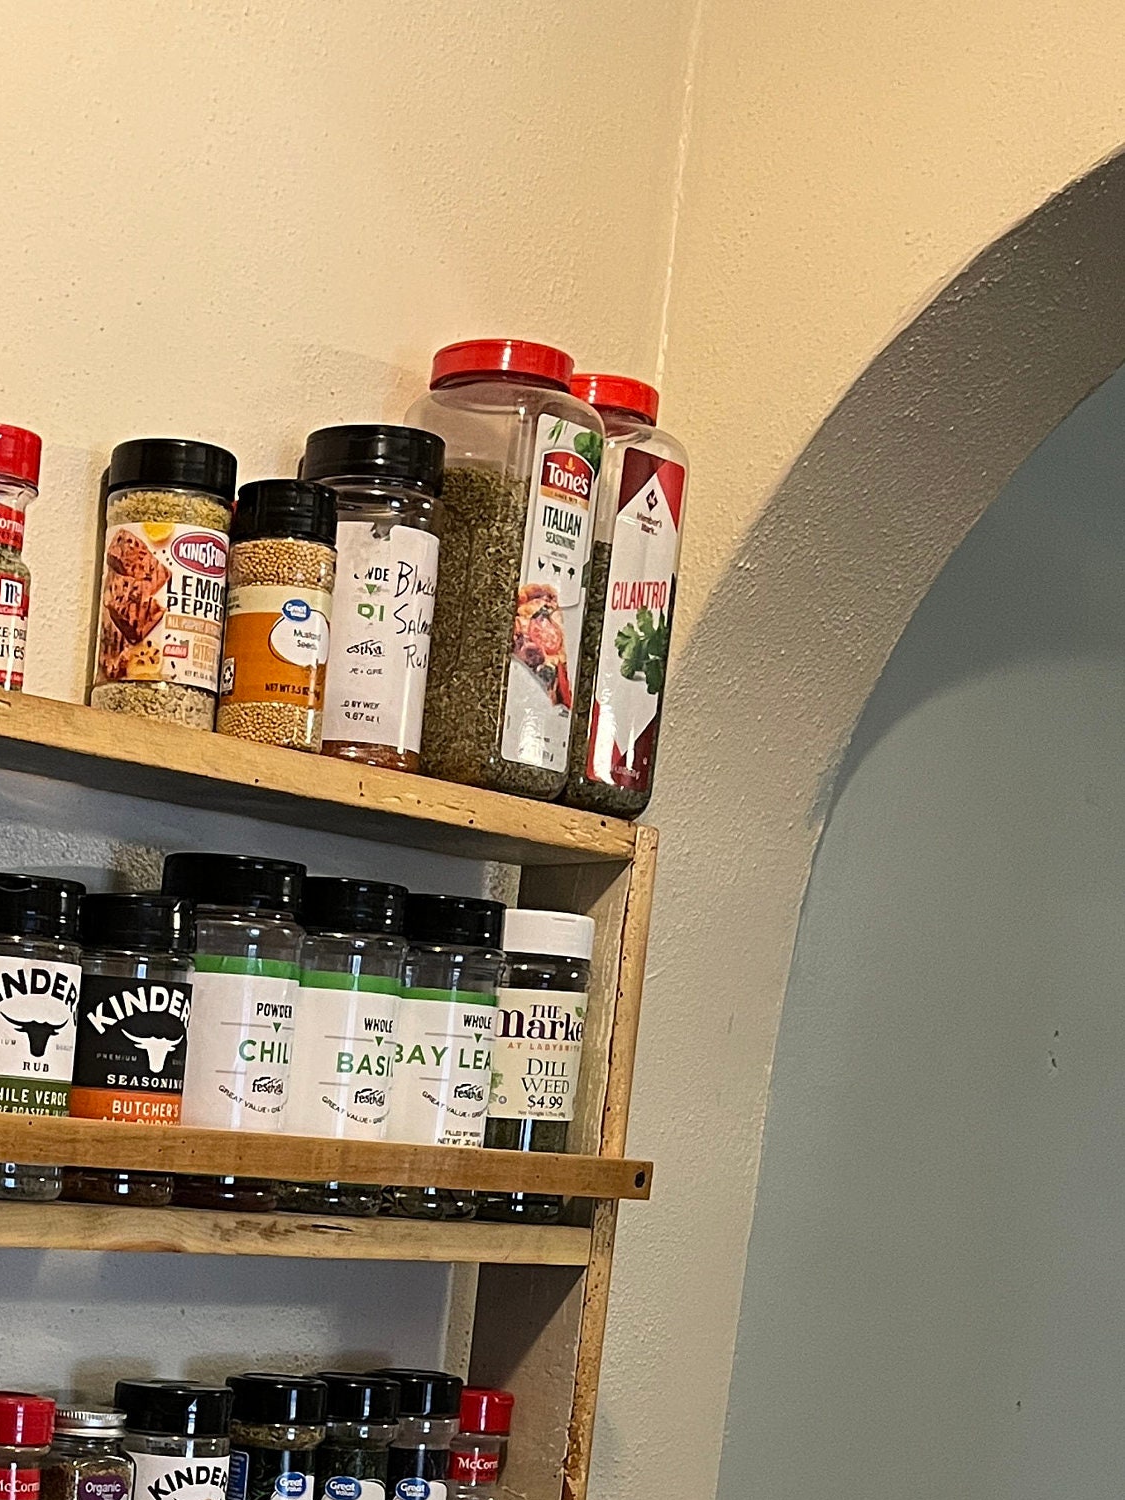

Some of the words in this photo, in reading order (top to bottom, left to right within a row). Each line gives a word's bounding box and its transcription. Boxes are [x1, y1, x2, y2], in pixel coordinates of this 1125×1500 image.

[543, 505, 582, 538] ITALIAN
[611, 581, 667, 611] CILANTRO
[256, 1002, 293, 1019] POWDER
[530, 1004, 562, 1019] THE
[364, 1017, 394, 1034] WHOLE
[463, 1014, 492, 1029] WHOLE
[394, 1043, 449, 1067] BAY
[23, 1061, 49, 1072] RUB
[526, 1058, 569, 1077] DILL
[521, 1077, 570, 1094] WEED
[36, 1090, 68, 1106] VERDE
[527, 1095, 563, 1110] $4.99
[112, 1100, 179, 1118] BUTCHER'S
[85, 1481, 122, 1497] Organic
[279, 1478, 303, 1488] Great
[329, 1481, 355, 1491] Great
